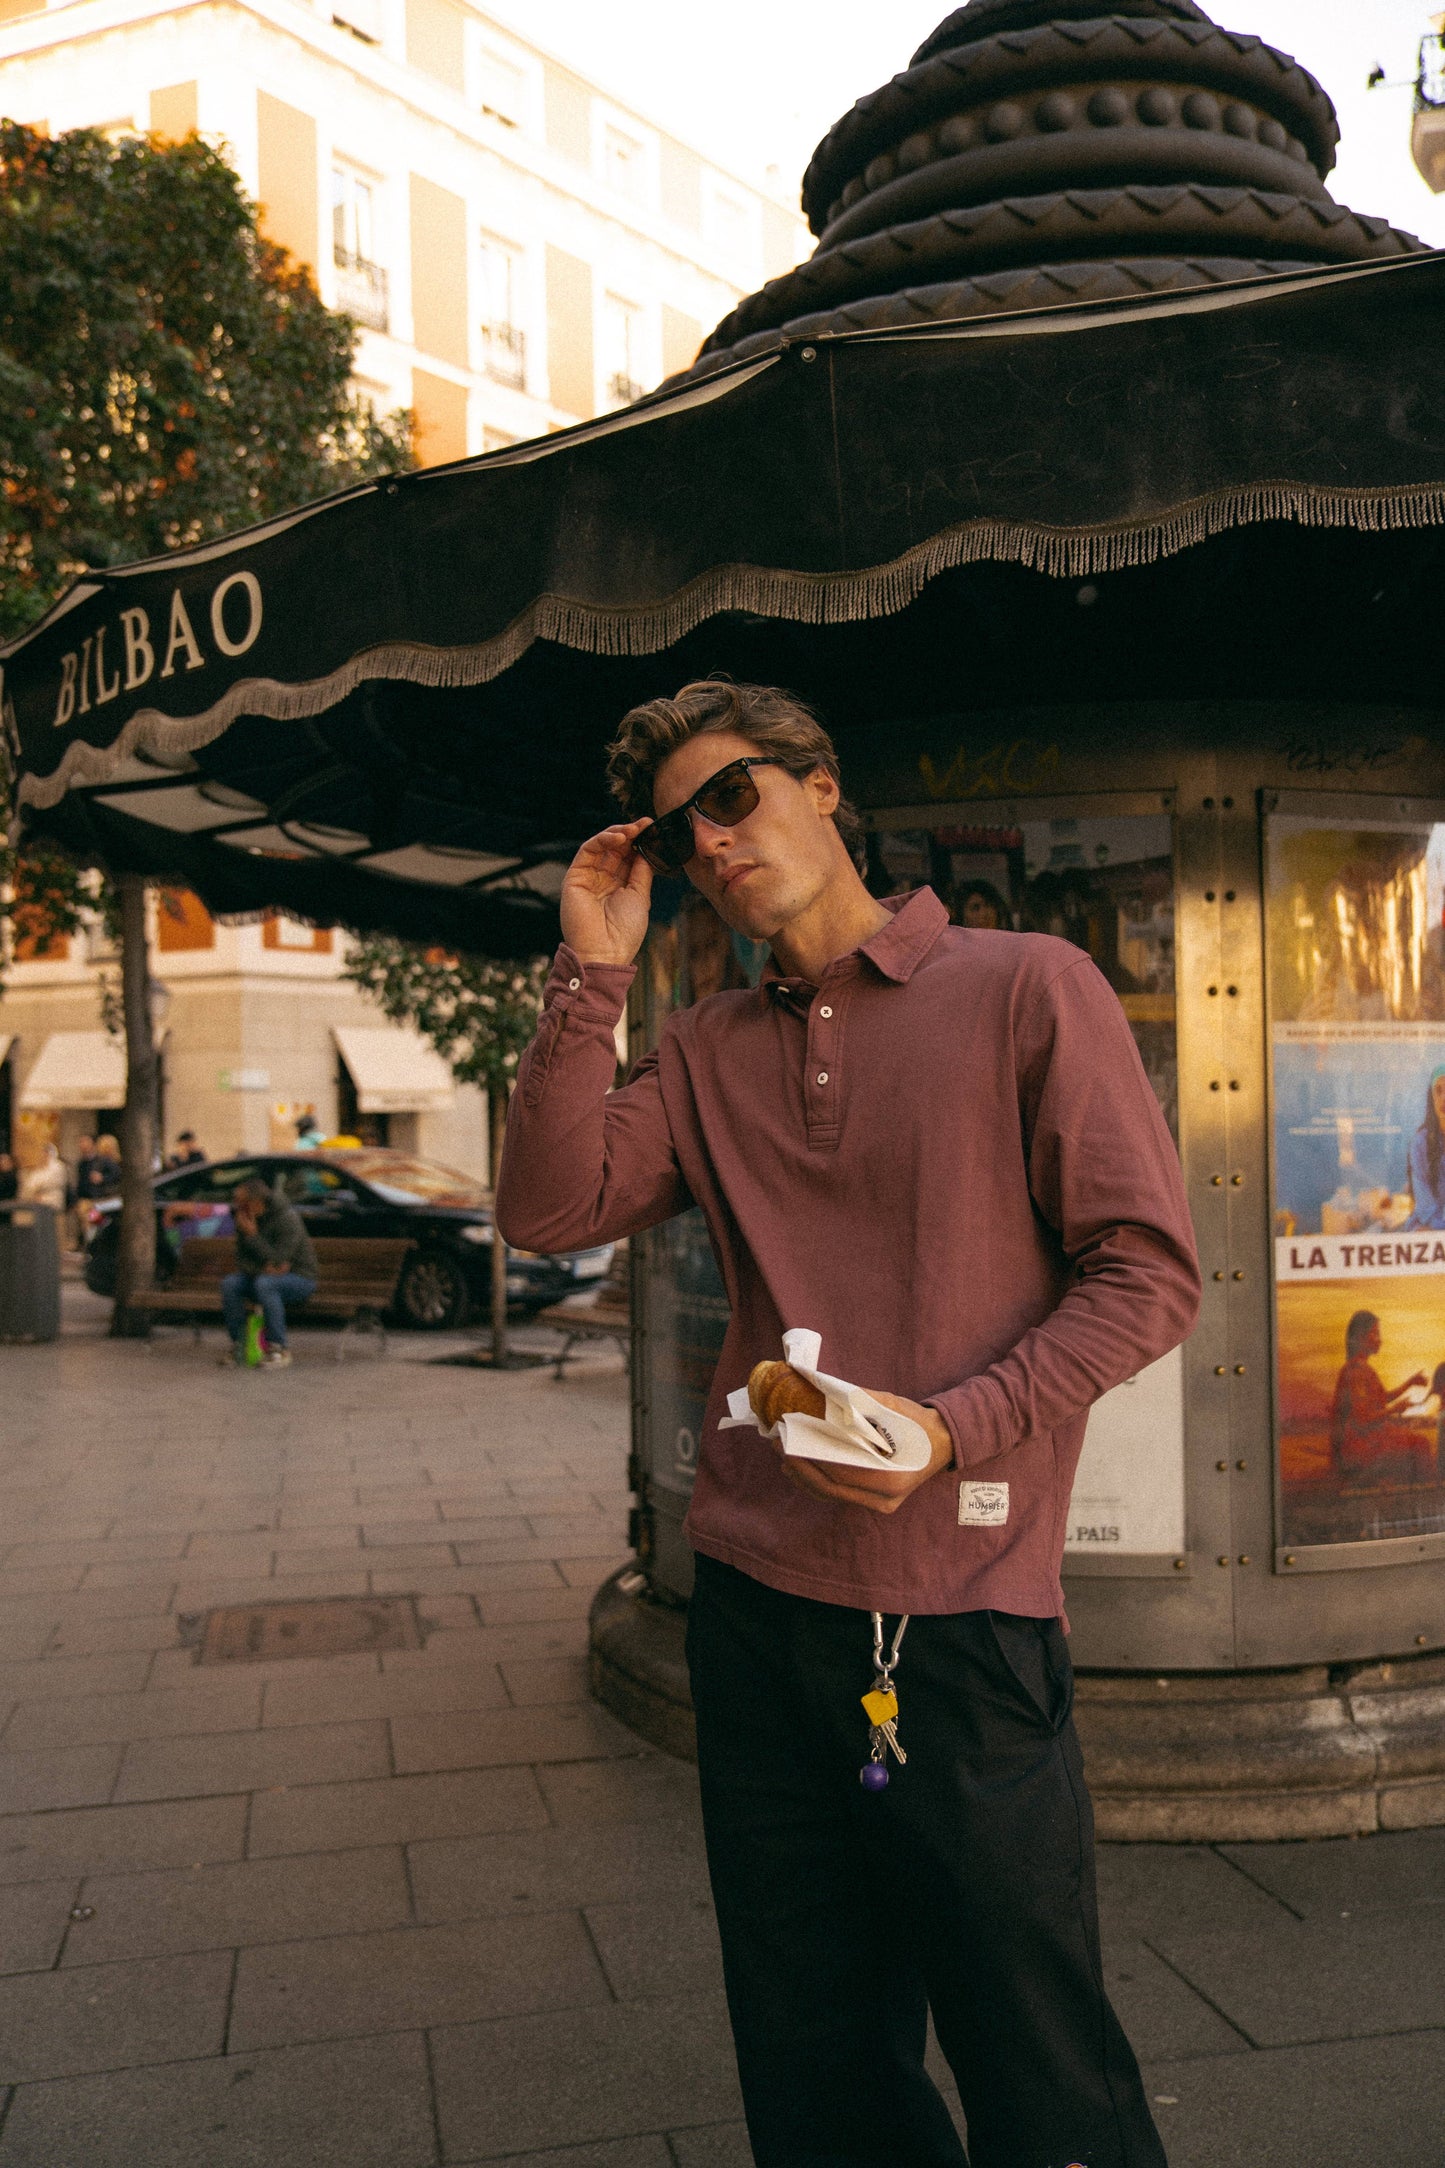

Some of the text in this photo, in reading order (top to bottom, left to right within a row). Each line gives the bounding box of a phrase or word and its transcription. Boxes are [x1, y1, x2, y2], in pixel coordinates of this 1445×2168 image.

[53, 570, 263, 727] BILBAO
[1290, 1240, 1445, 1269] LA TRENZA
